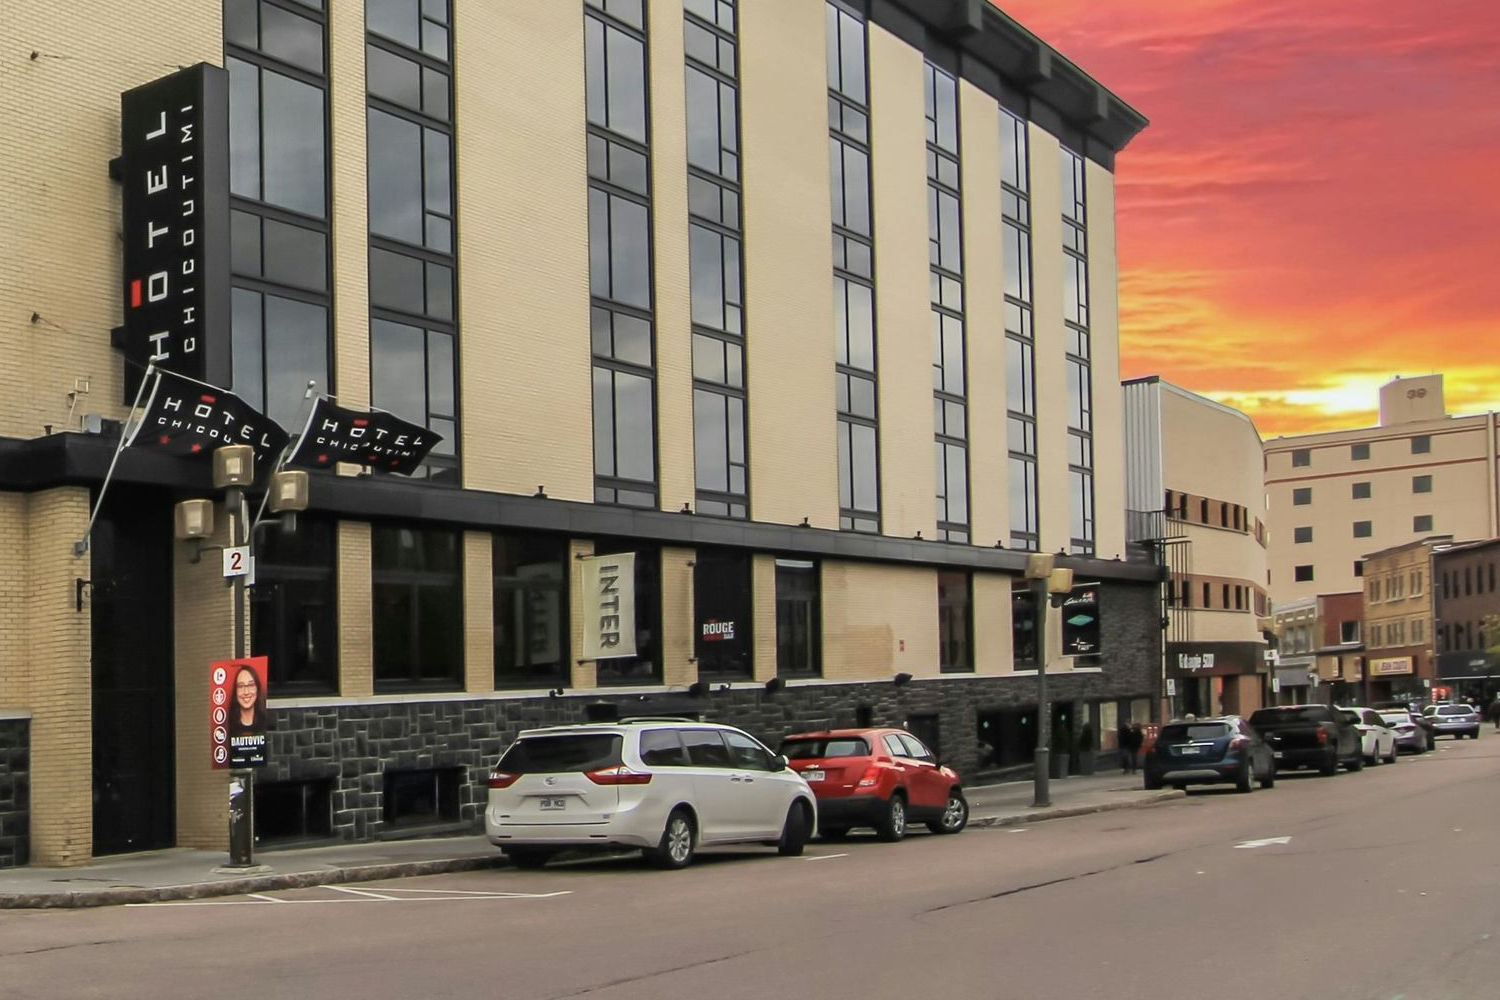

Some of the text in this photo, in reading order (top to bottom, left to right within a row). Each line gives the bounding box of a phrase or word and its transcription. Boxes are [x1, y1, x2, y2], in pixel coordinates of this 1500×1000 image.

[145, 111, 170, 362] HOTEL
[180, 104, 196, 354] CHICOUTIMI
[163, 396, 271, 448] HOTEL
[321, 418, 423, 447] HOTEL
[231, 552, 242, 571] 2
[599, 564, 621, 650] INTER
[703, 621, 735, 636] ROUGE
